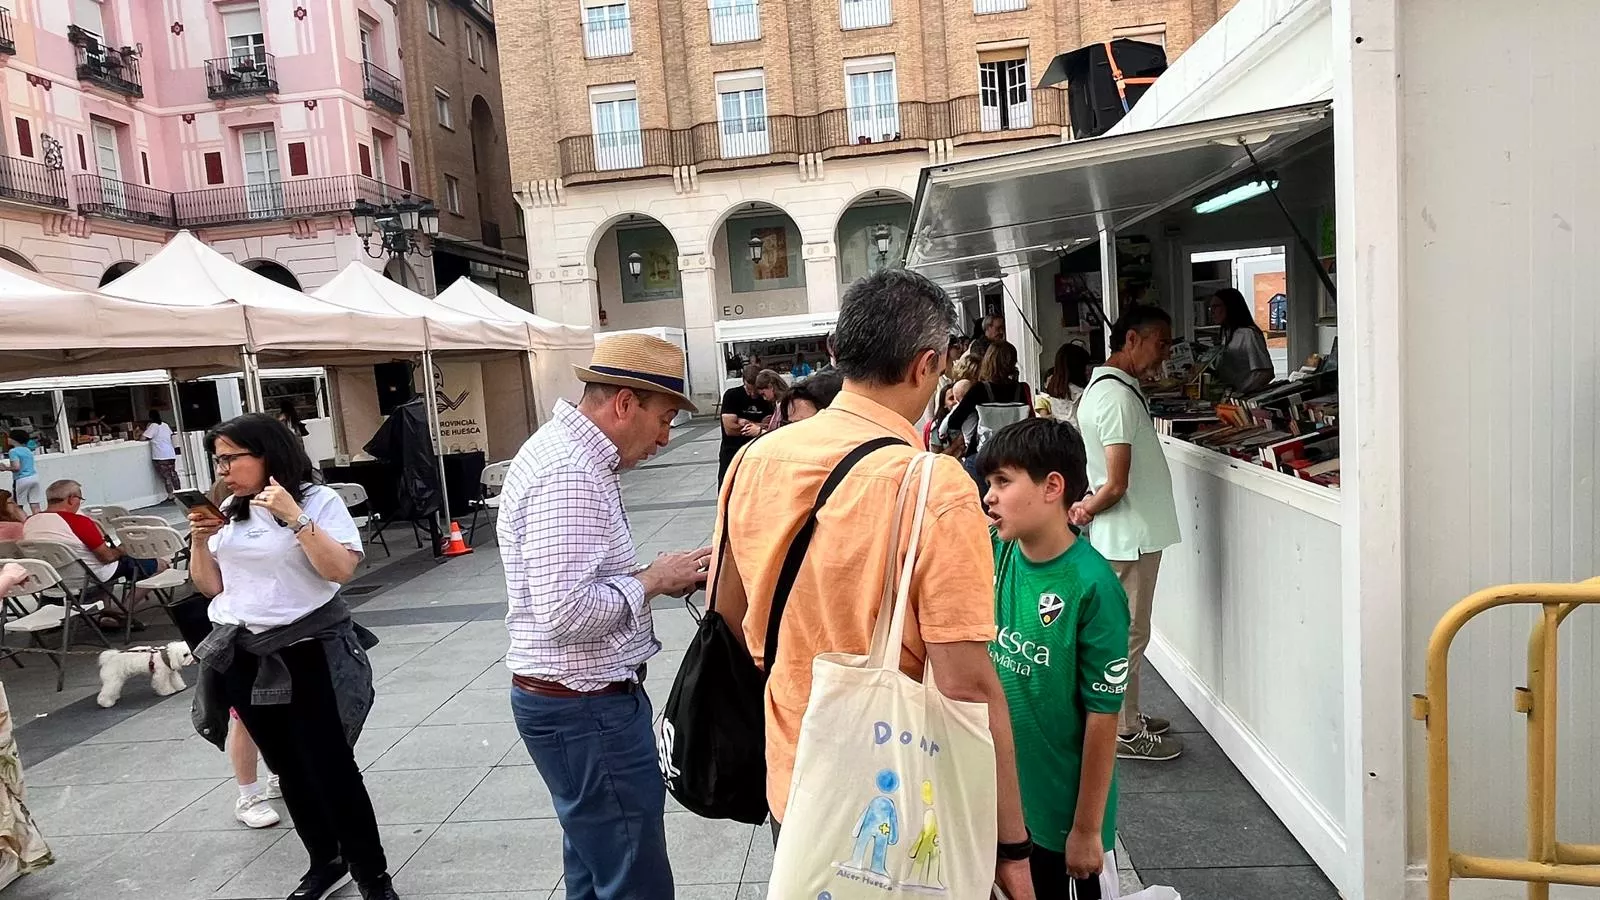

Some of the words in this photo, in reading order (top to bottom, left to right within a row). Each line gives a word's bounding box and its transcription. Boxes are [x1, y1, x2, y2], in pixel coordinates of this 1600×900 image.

[723, 304, 744, 316] EO
[440, 419, 477, 428] ROVINCIAL
[452, 427, 480, 435] HUESCA
[996, 626, 1050, 667] esca
